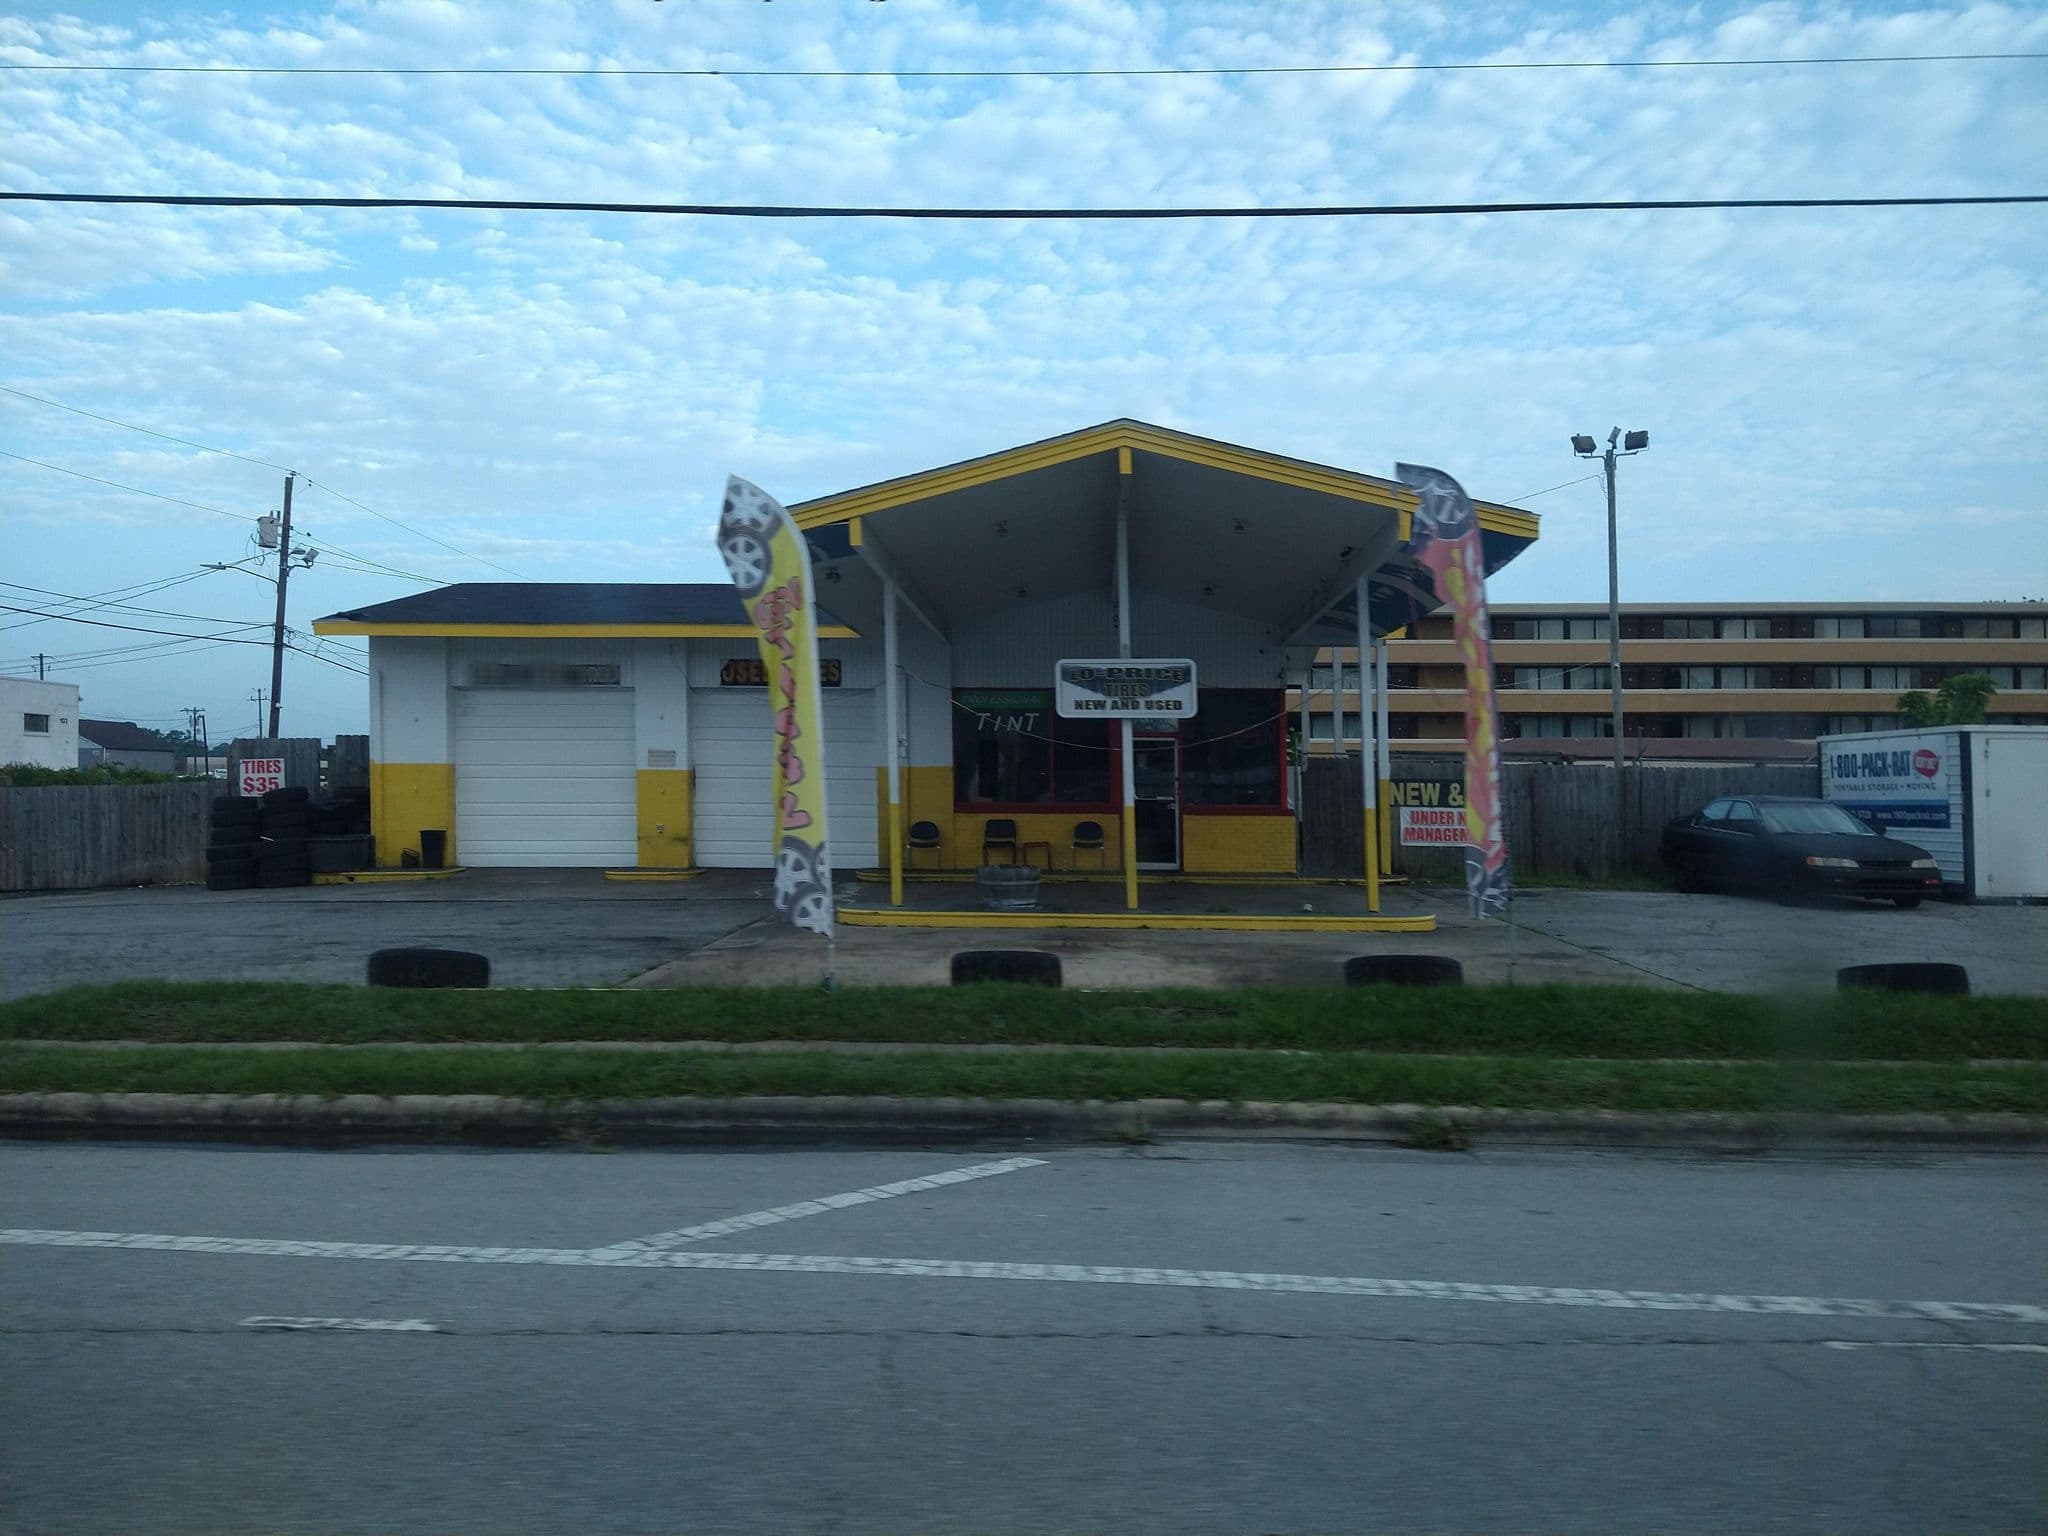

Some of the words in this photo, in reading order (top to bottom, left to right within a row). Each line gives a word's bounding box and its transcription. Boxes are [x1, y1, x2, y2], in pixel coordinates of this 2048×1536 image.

[1104, 683, 1149, 697] TIRES
[1074, 700, 1106, 711] NEW
[1111, 700, 1140, 711] AND
[1145, 700, 1182, 711] USED
[976, 713, 1039, 732] TINT
[242, 760, 281, 774] TIRES
[243, 776, 280, 795] $35
[1868, 782, 1898, 791] STORAGE
[1906, 781, 1936, 791] MOVING
[1390, 782, 1440, 806] NEW
[1448, 782, 1464, 806] &
[1410, 810, 1454, 825] UNDER
